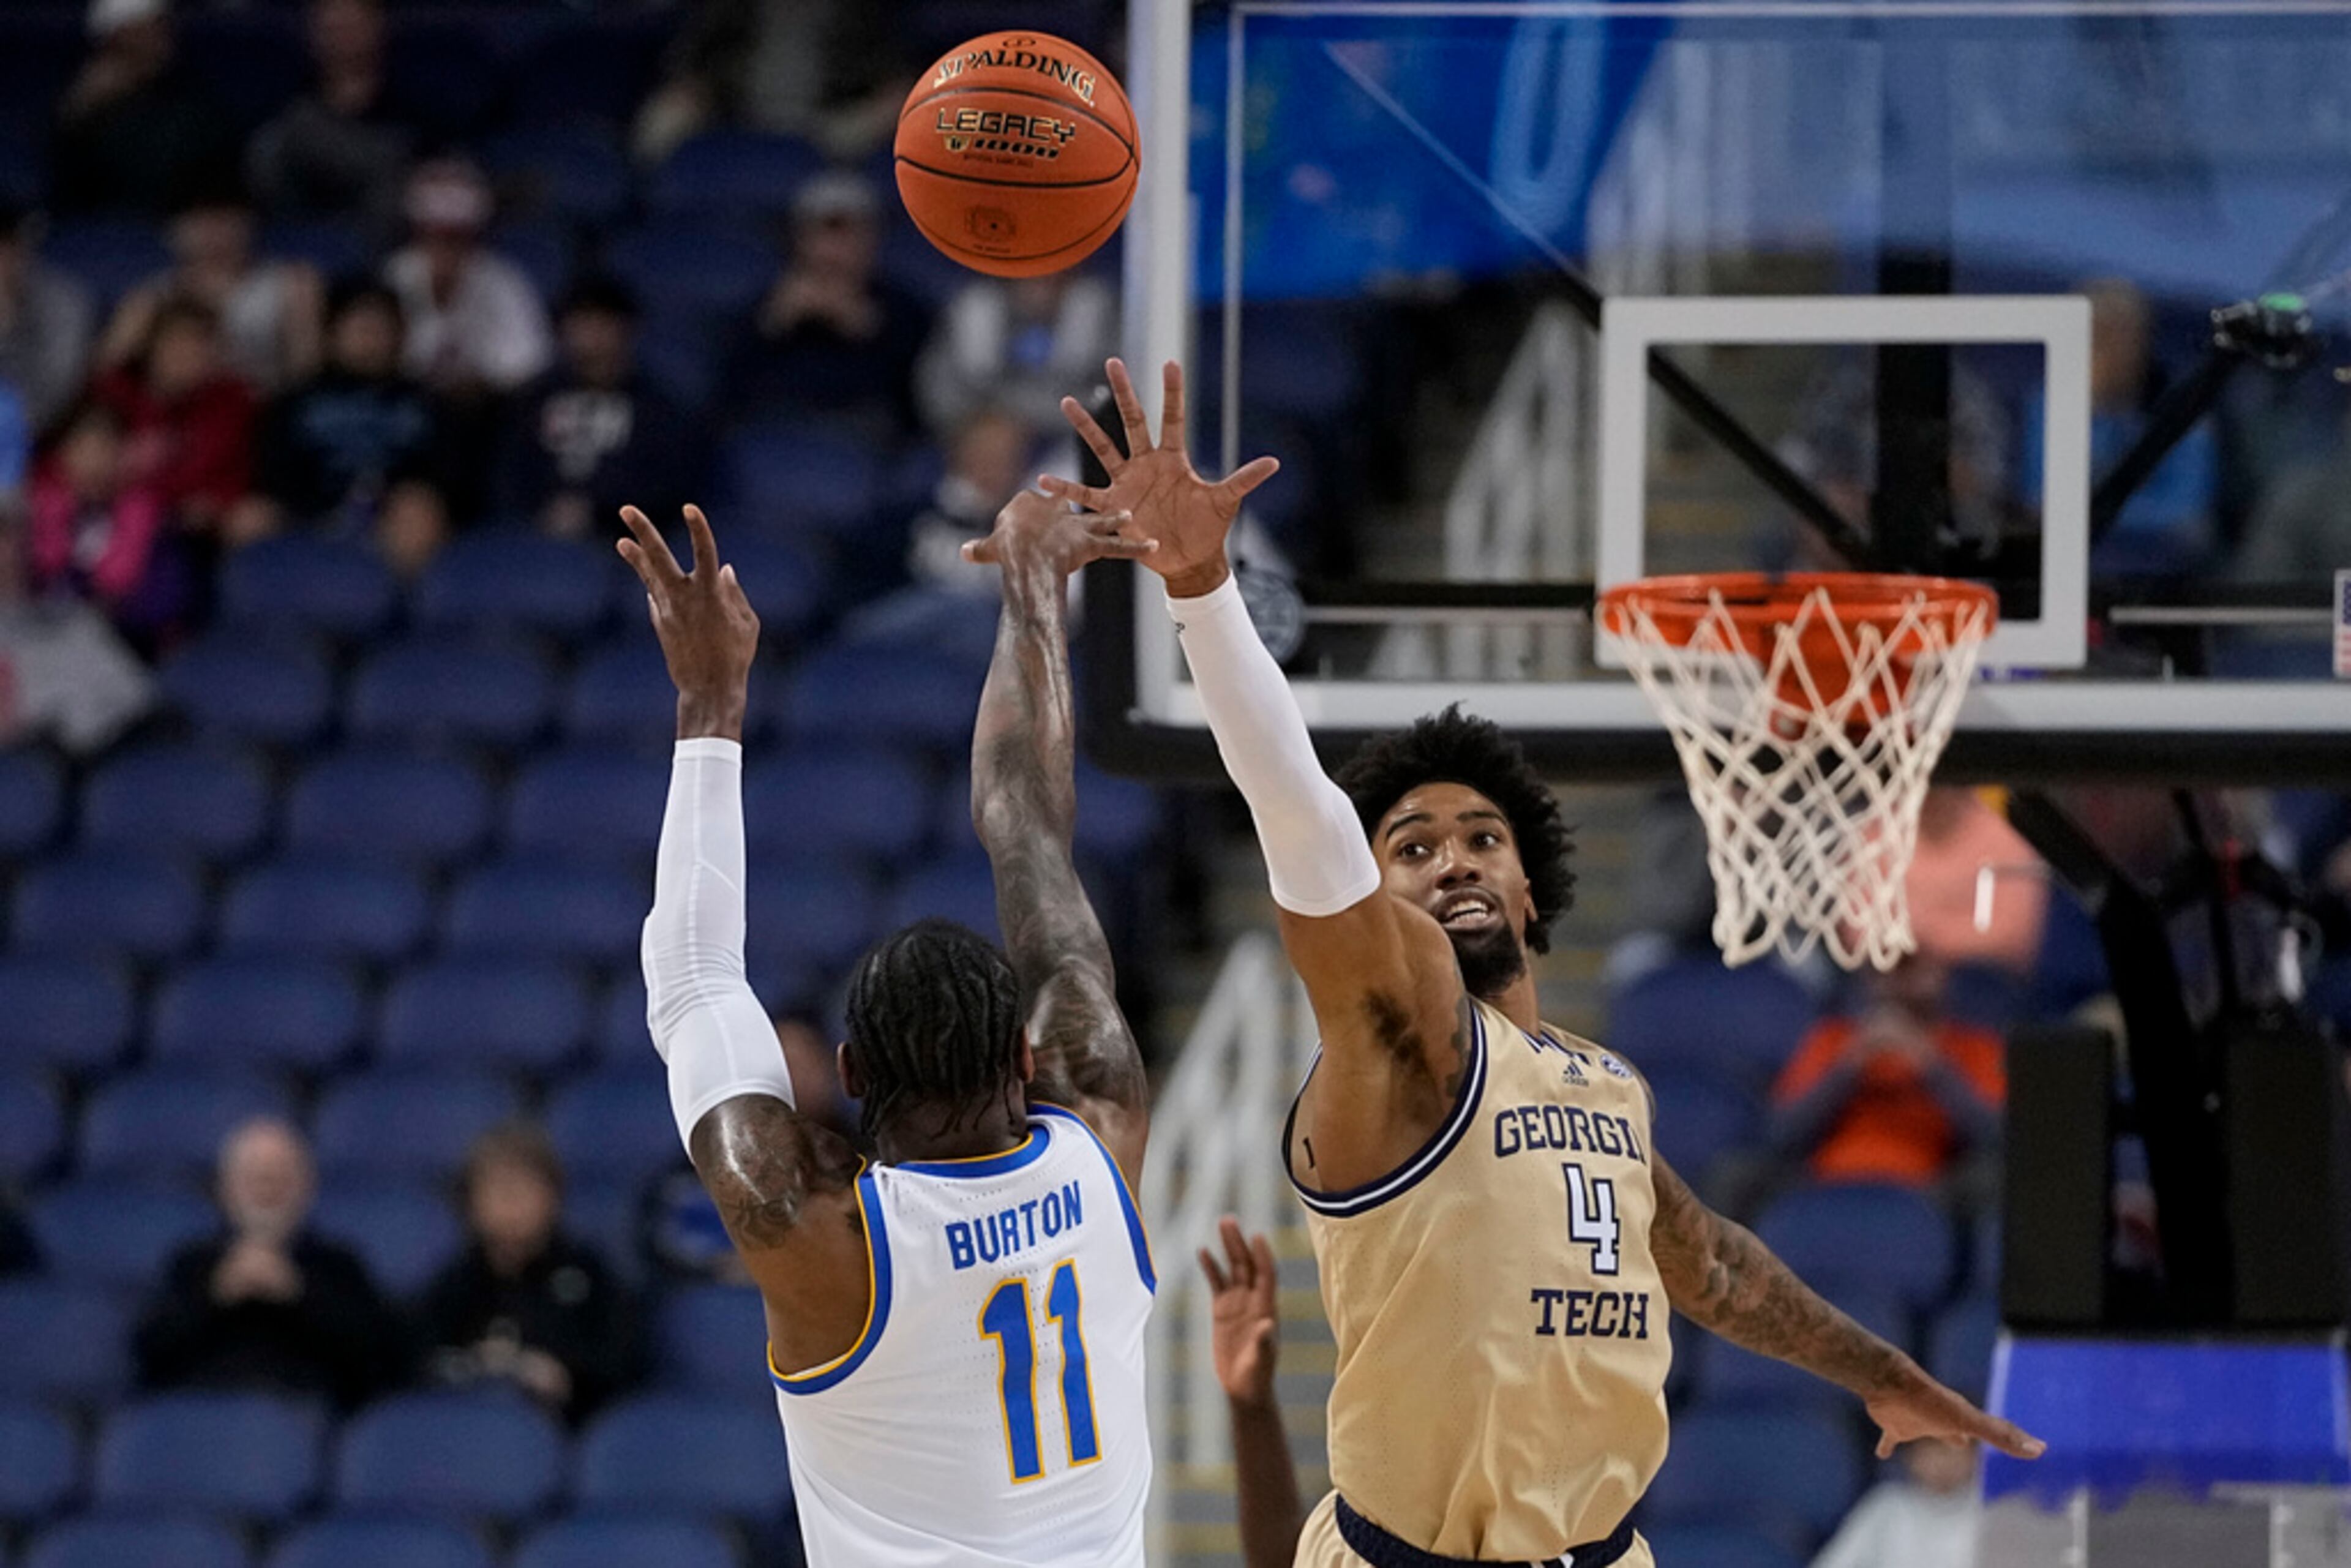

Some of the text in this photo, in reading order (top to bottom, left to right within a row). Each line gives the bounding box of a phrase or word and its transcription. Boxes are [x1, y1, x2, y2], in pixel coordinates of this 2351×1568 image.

[934, 49, 1095, 104] SPALDING
[936, 108, 1076, 148] LEGACY
[1494, 1105, 1646, 1166] GEORGI
[945, 1180, 1082, 1270] BURTON
[1562, 1163, 1620, 1276] 4
[1531, 1288, 1649, 1340] TECH
[977, 1258, 1103, 1485] 11
